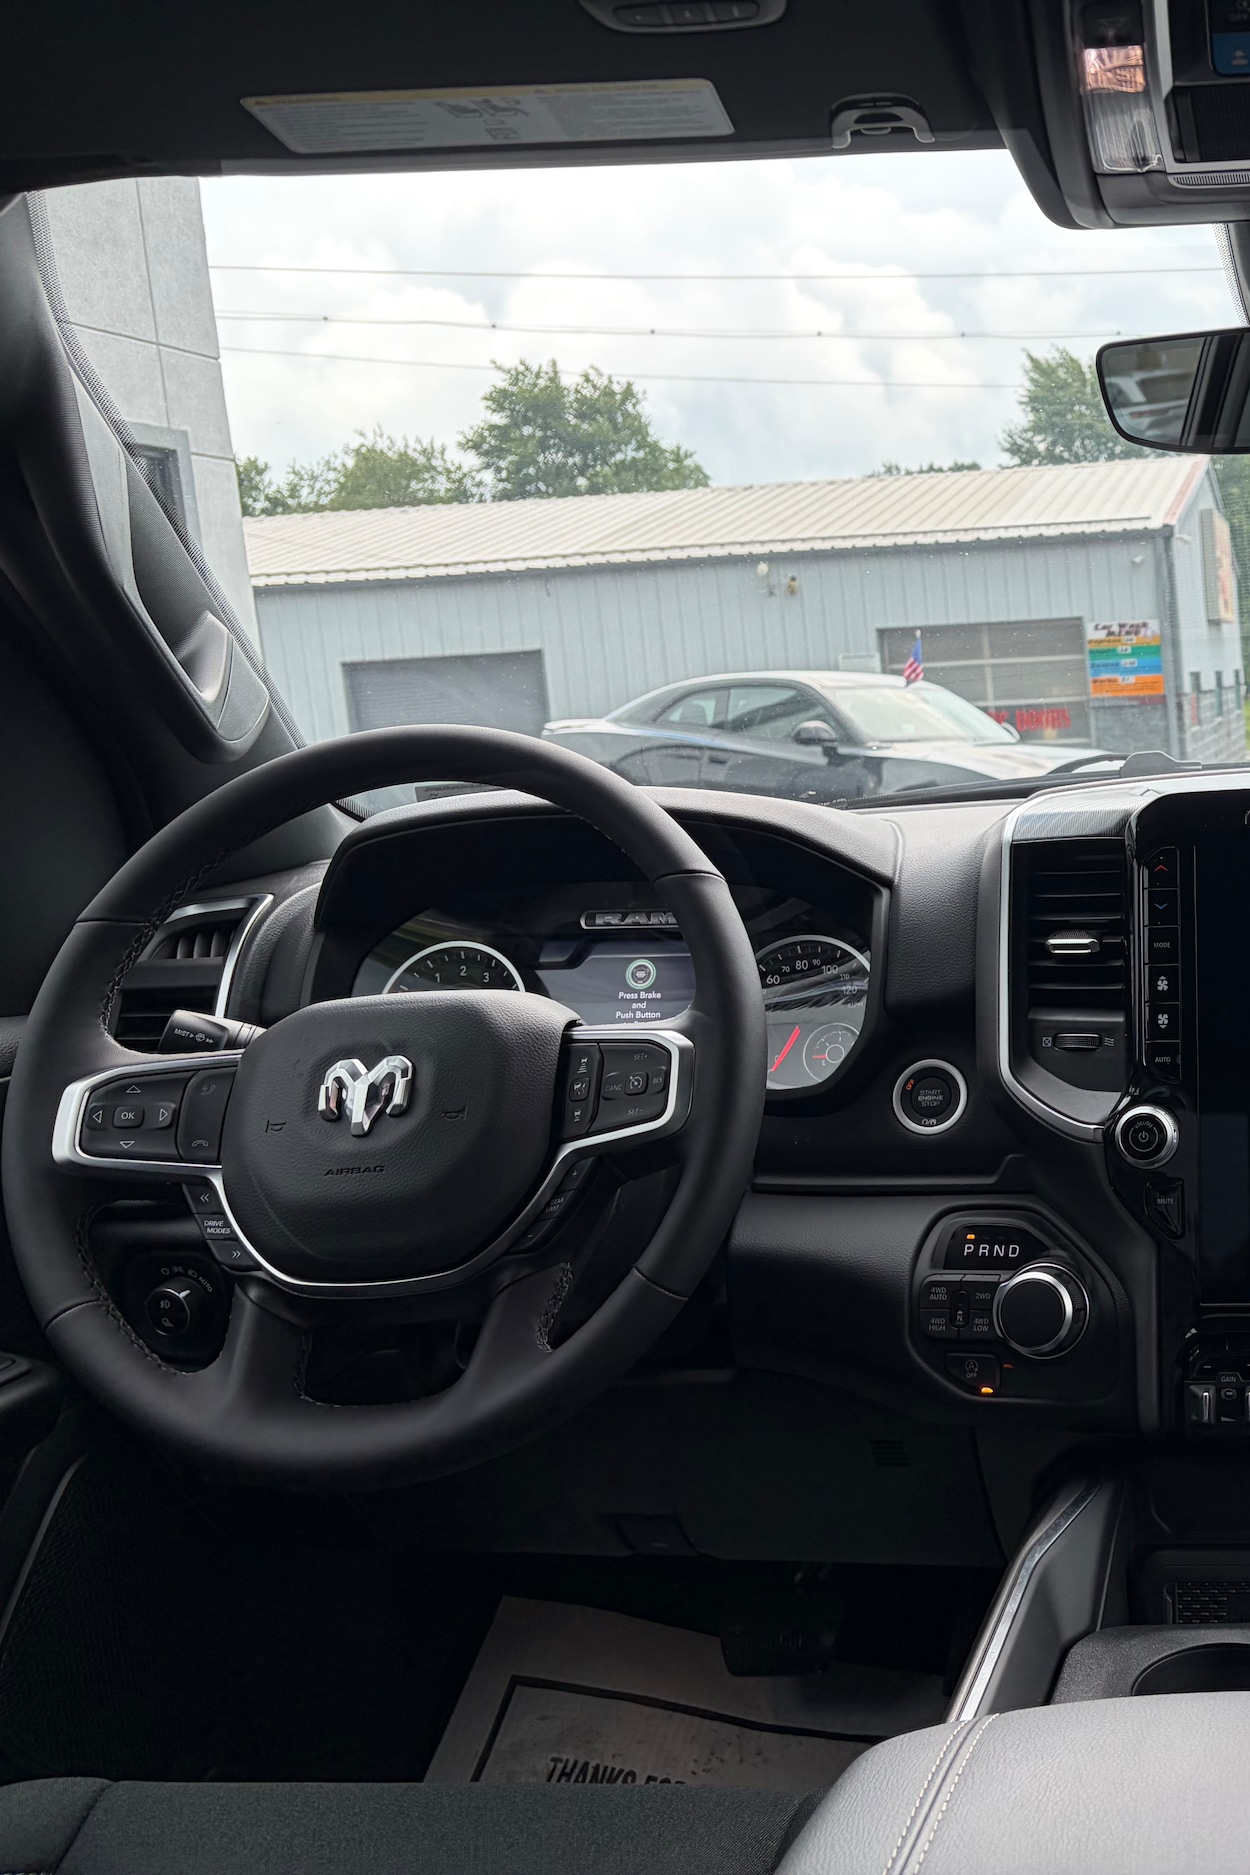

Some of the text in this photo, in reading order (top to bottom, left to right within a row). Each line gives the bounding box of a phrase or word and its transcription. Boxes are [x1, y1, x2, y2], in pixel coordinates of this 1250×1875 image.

[594, 912, 679, 926] RAM
[1153, 941, 1171, 949] MODE
[795, 959, 809, 970] 80
[812, 959, 821, 967] 90
[459, 965, 468, 977] 2
[821, 964, 840, 975] 100
[434, 972, 442, 983] 1
[482, 971, 491, 983] 3
[765, 975, 781, 985] 60
[618, 990, 662, 999] Press Brake
[631, 1001, 647, 1009] and
[615, 1010, 661, 1019] Push Button
[173, 1027, 191, 1039] MIST
[652, 1076, 664, 1085] RES
[919, 1088, 943, 1096] START
[120, 1110, 135, 1121] OK
[324, 1164, 386, 1178] AIRBAG
[203, 1219, 225, 1227] DRIVE
[206, 1226, 232, 1236] MODES
[930, 1286, 947, 1294] 4WD
[929, 1293, 948, 1301] AUTO
[975, 1292, 991, 1300] 2WD
[930, 1317, 946, 1325] 4WD
[956, 1314, 963, 1322] N
[973, 1317, 990, 1325] 4WD
[928, 1324, 946, 1332] HIGH
[973, 1324, 989, 1332] LOW
[1220, 1375, 1237, 1383] GAIN
